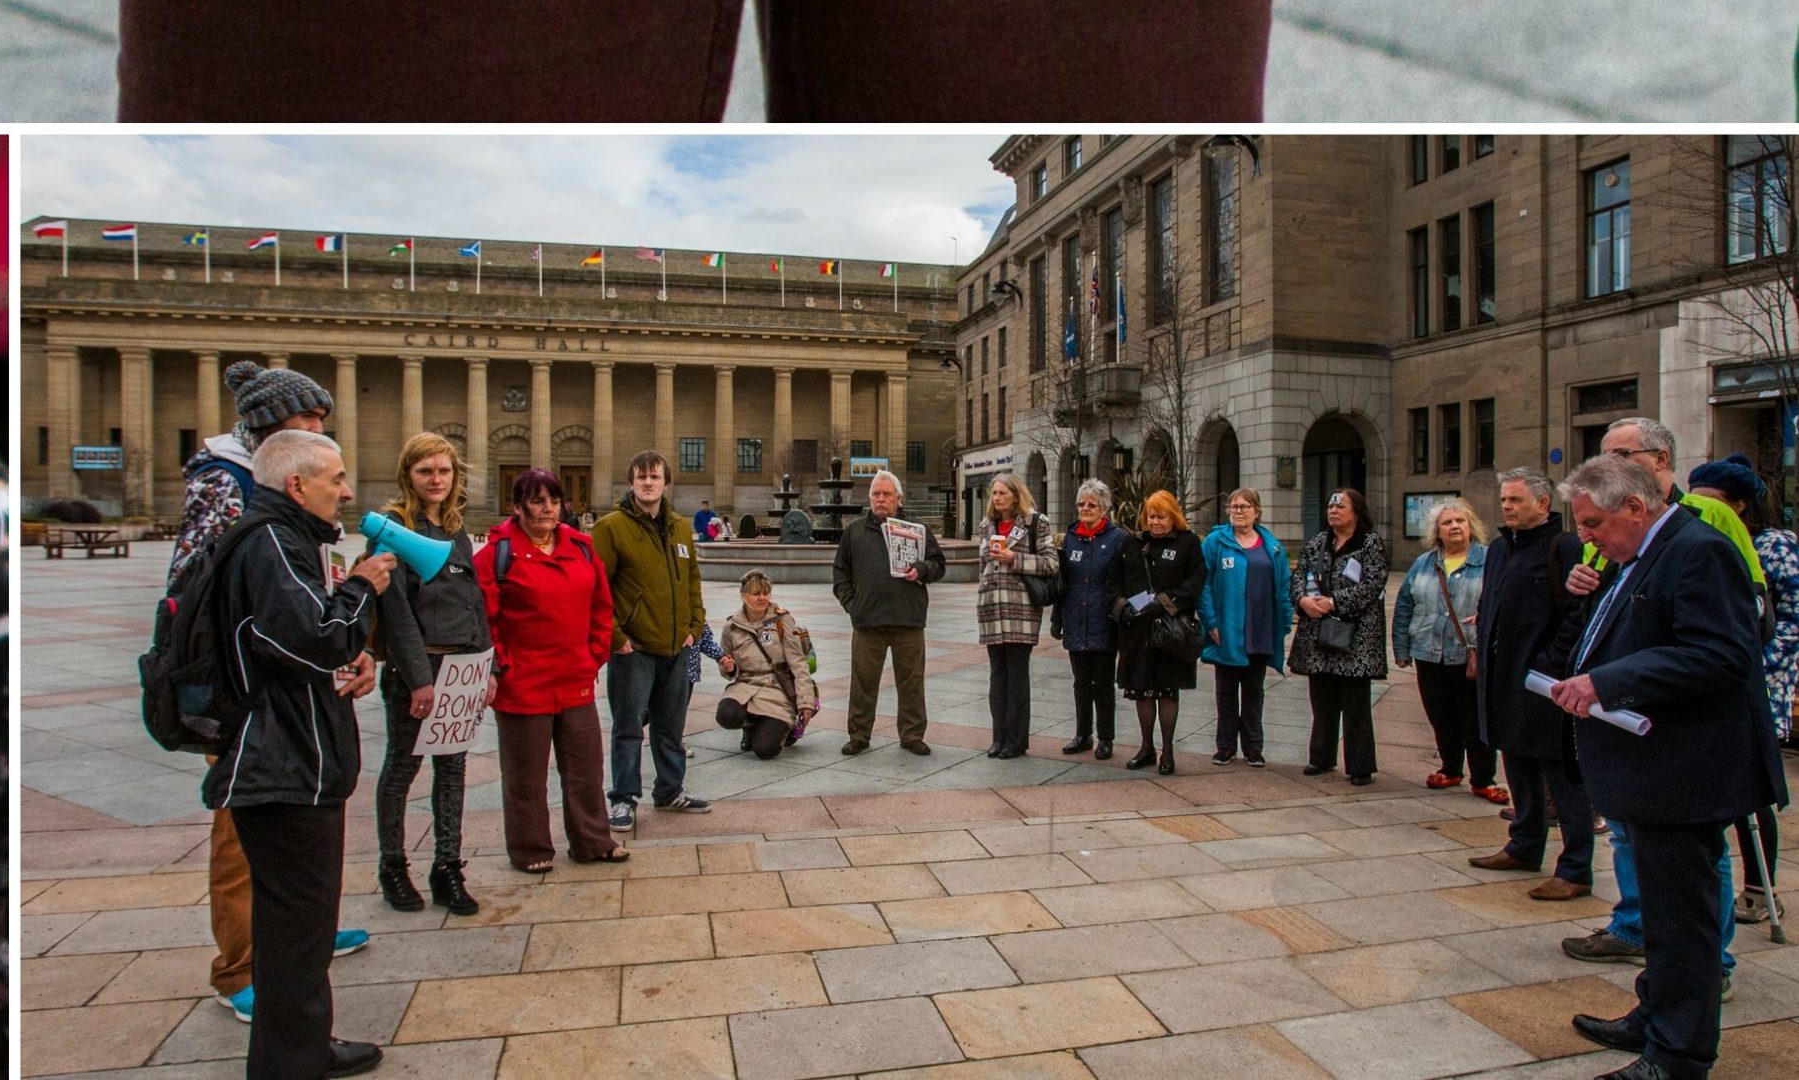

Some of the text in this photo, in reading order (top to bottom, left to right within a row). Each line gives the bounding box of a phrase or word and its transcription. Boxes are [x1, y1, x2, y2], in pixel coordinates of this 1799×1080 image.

[404, 333, 610, 352] CAIRD HALL
[445, 657, 491, 686] DONT
[435, 688, 486, 719] BOMB
[426, 718, 477, 745] SYRIA
